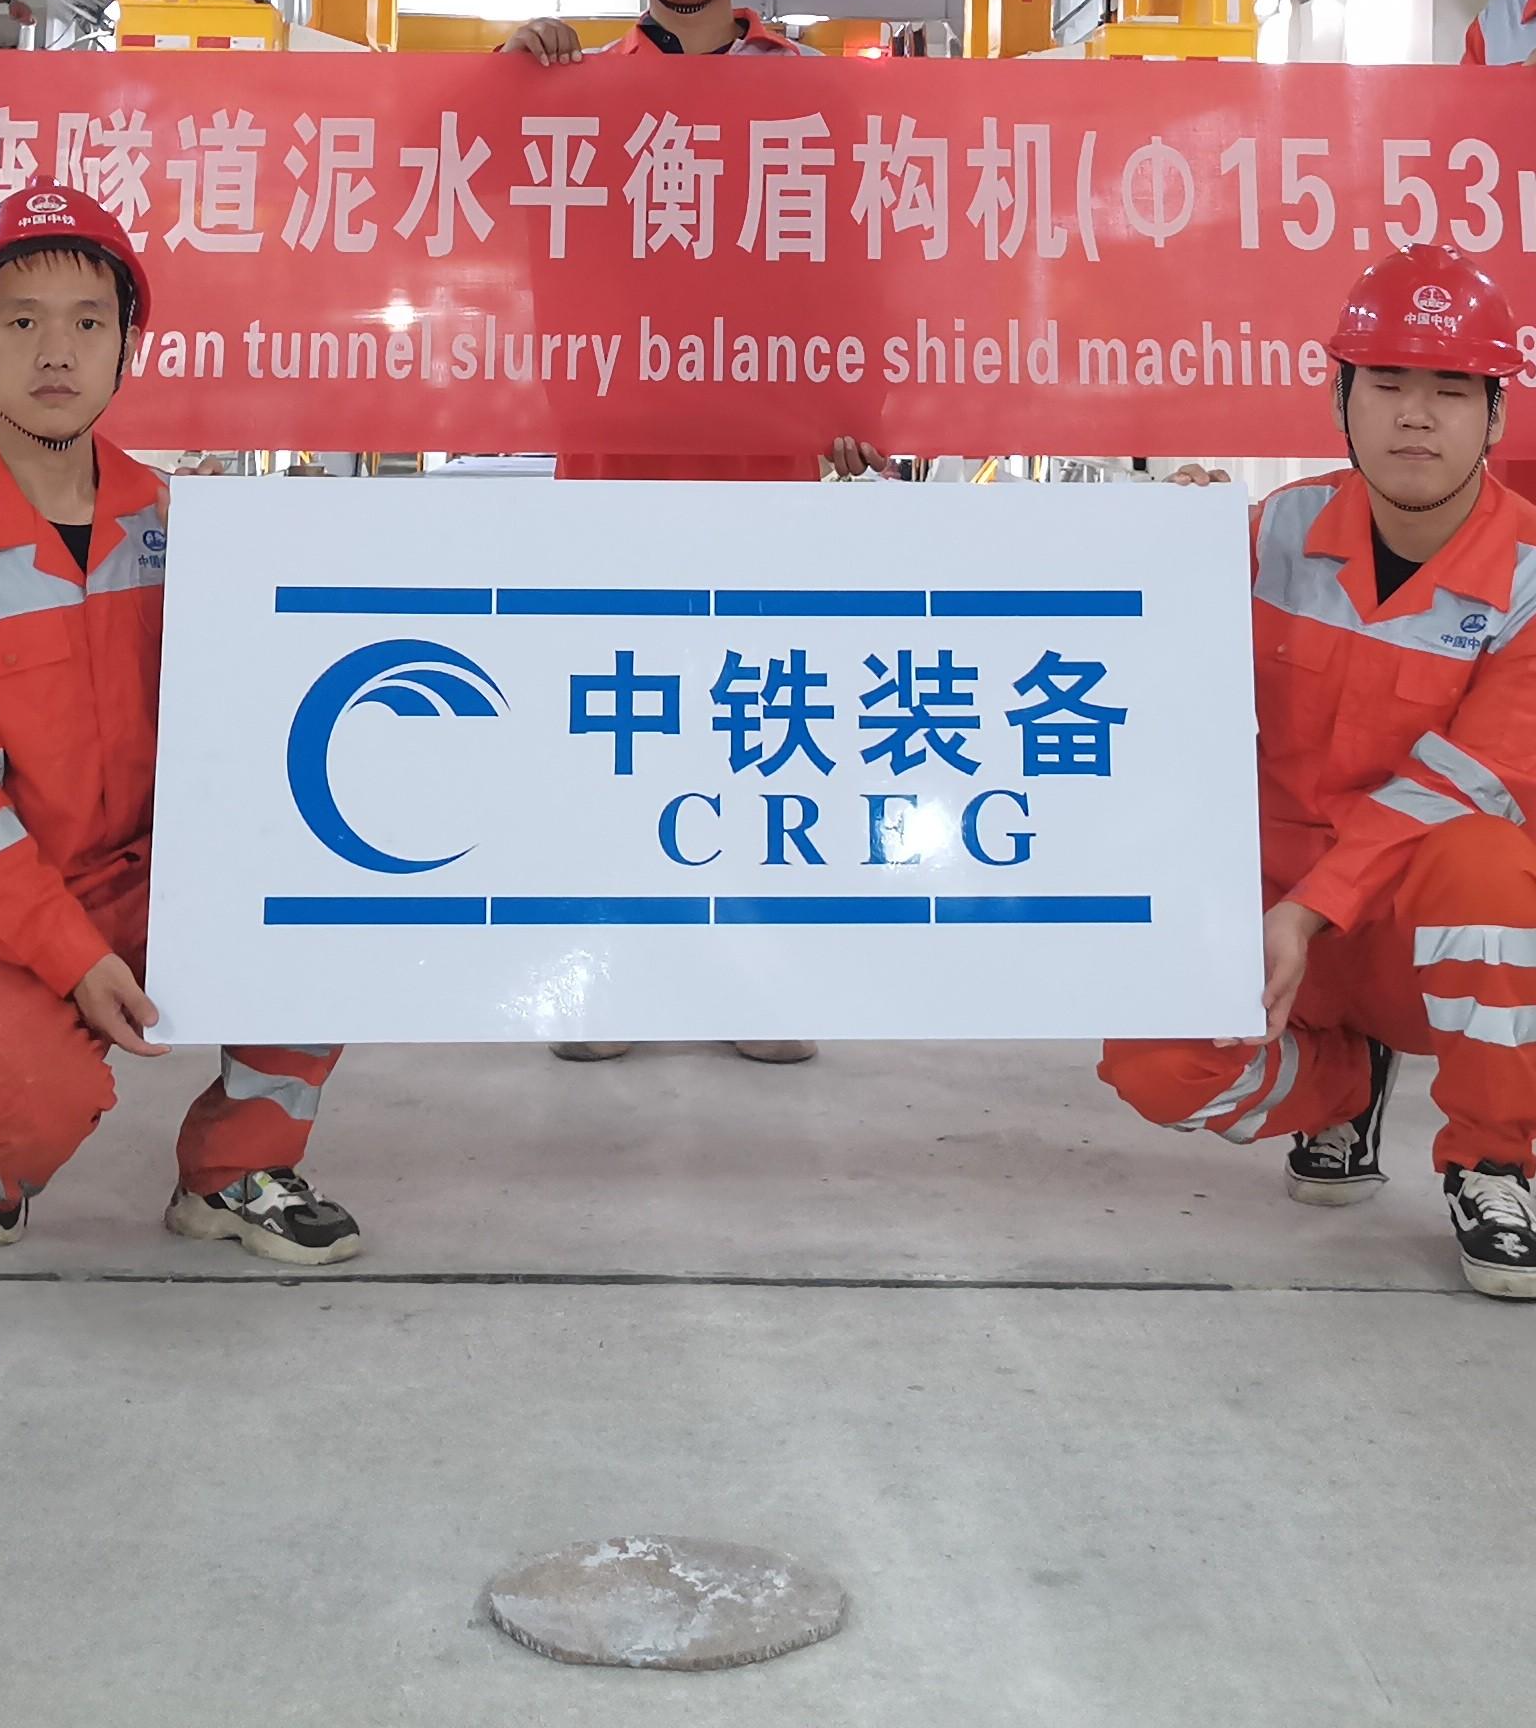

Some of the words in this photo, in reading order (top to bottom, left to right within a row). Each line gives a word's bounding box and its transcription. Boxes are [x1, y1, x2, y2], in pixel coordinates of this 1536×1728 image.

[17, 213, 77, 227] 中国中铁
[243, 313, 433, 381] tunnel
[451, 314, 622, 397] slurry
[639, 315, 865, 384] balance
[882, 317, 1059, 386] shield
[1078, 319, 1330, 389] machine
[1440, 633, 1482, 651] 中国中
[566, 648, 1129, 779] 中铁装备
[658, 788, 1037, 868] CREG
